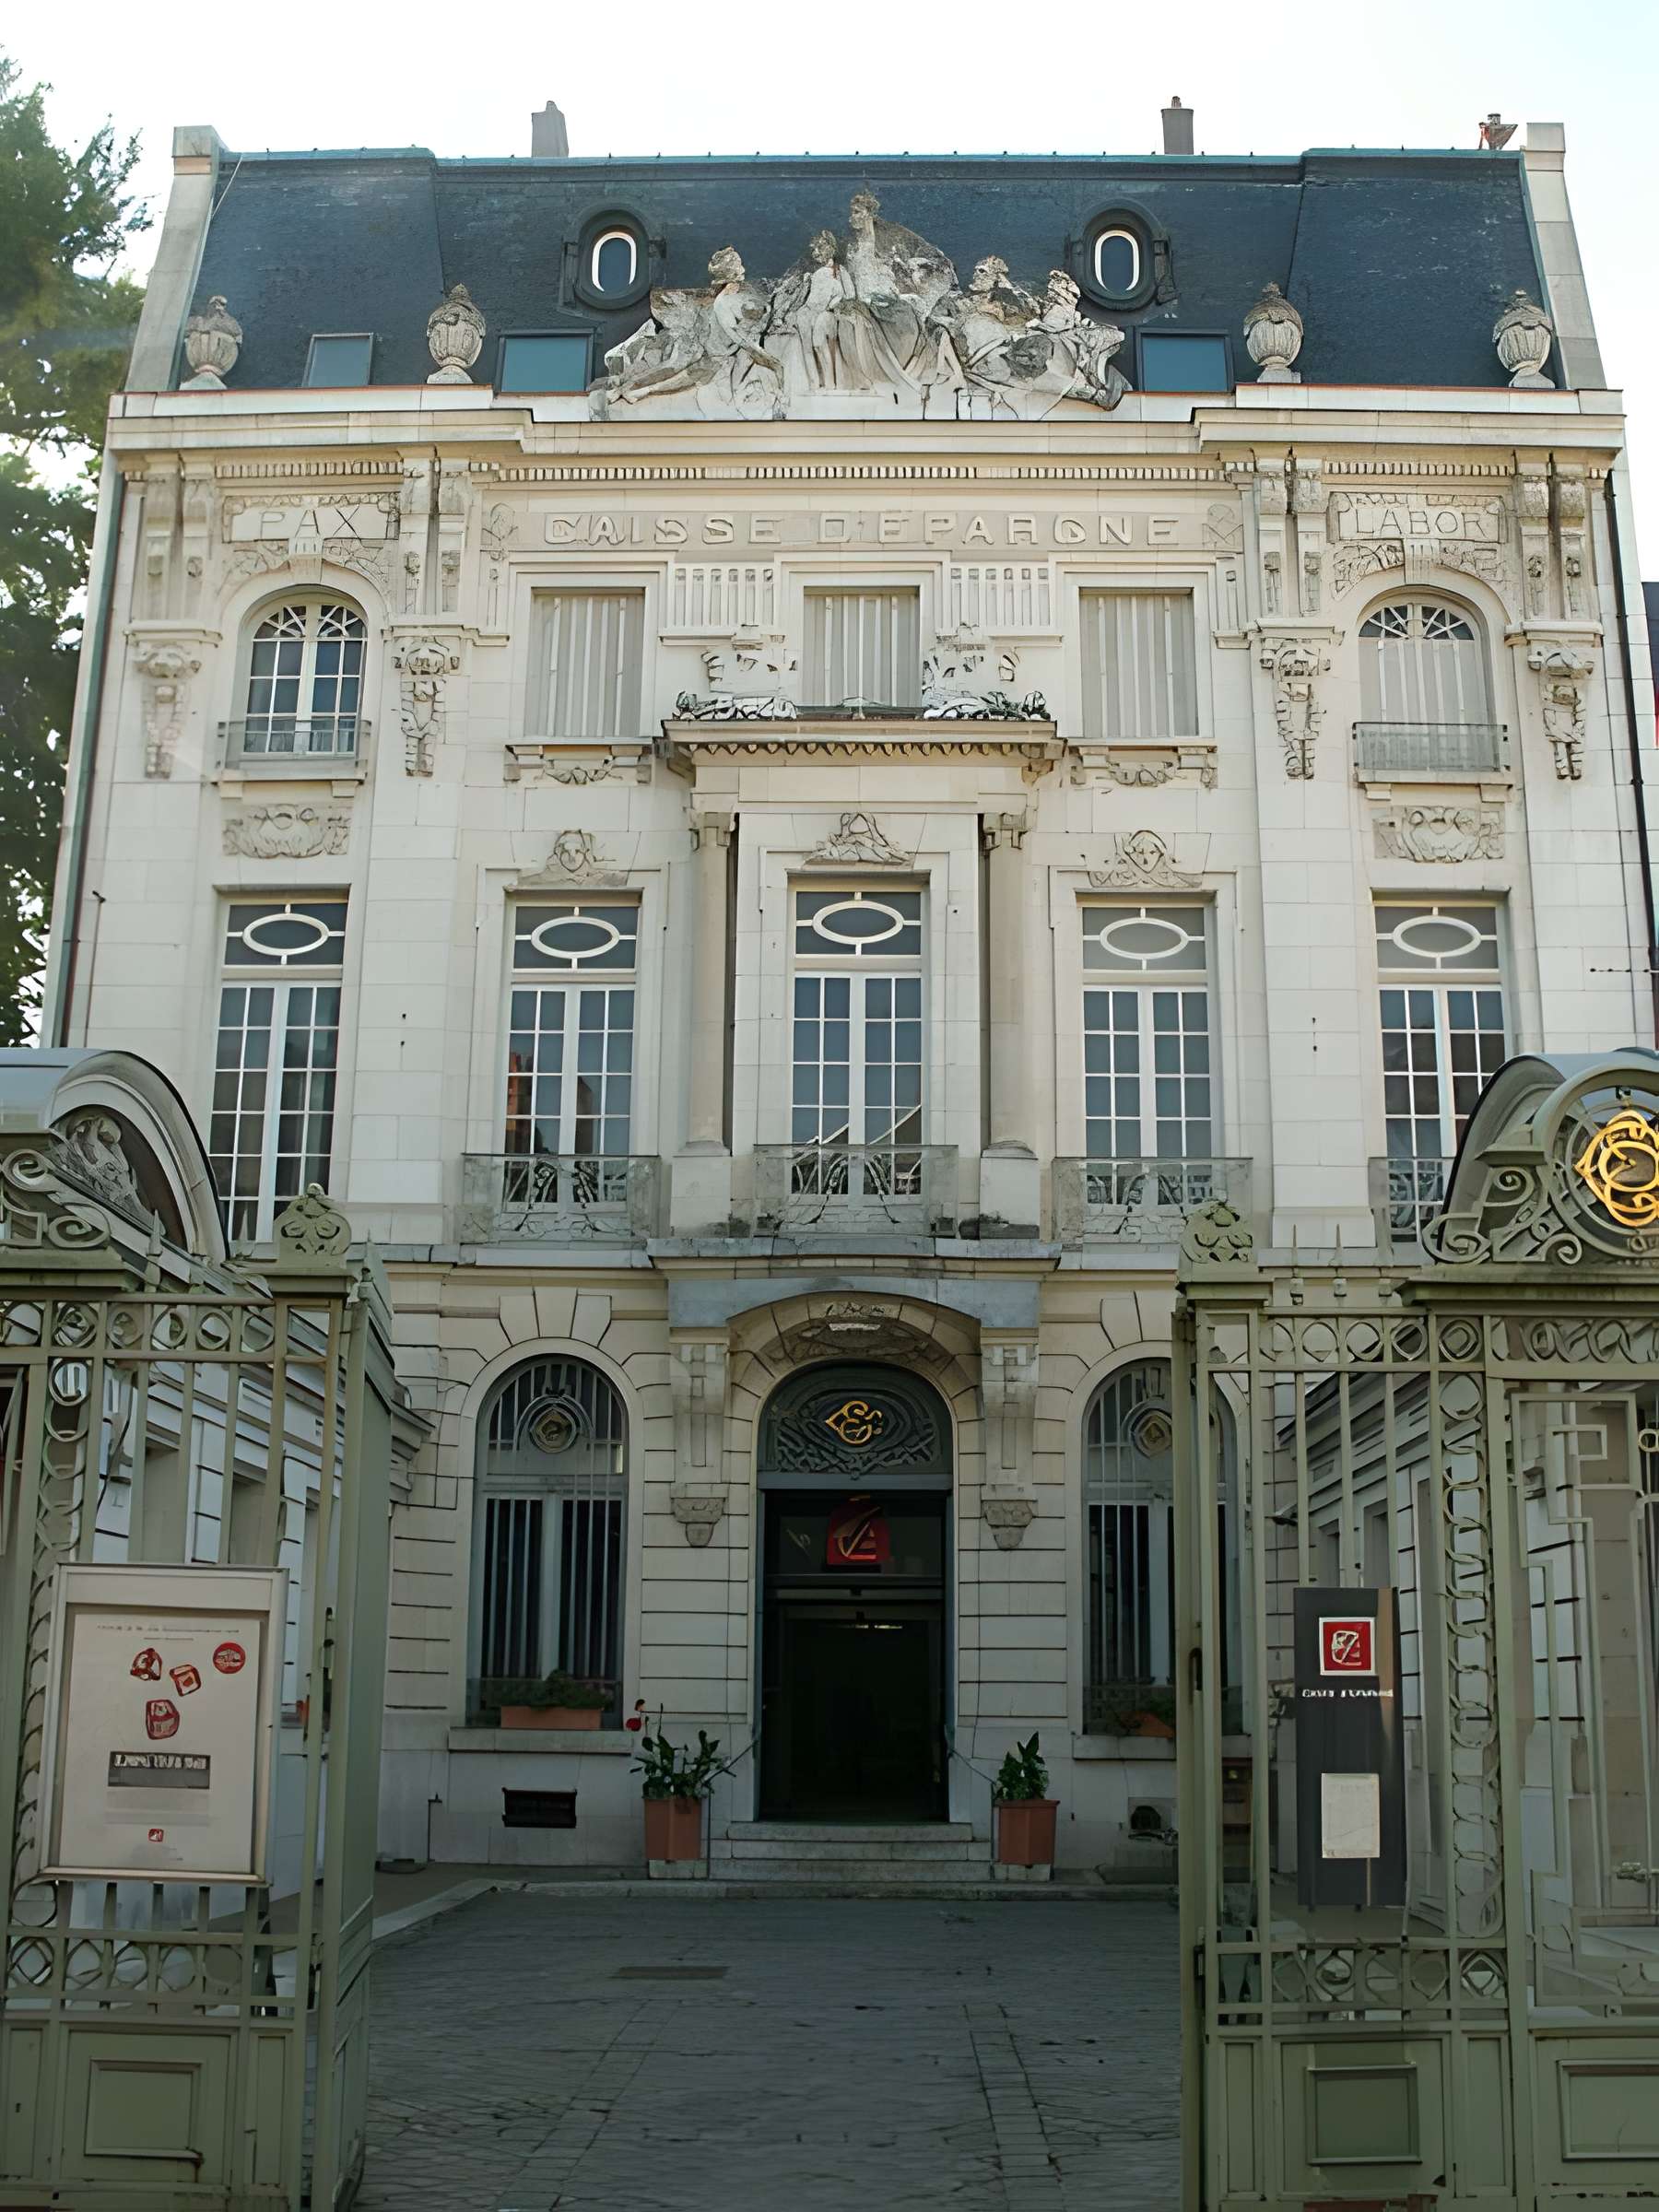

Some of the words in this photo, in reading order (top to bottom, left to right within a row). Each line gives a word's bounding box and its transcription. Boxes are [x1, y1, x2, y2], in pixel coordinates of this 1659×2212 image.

[259, 508, 360, 537] PAX
[544, 513, 782, 546] CAISSE
[1356, 509, 1487, 537] LABOR
